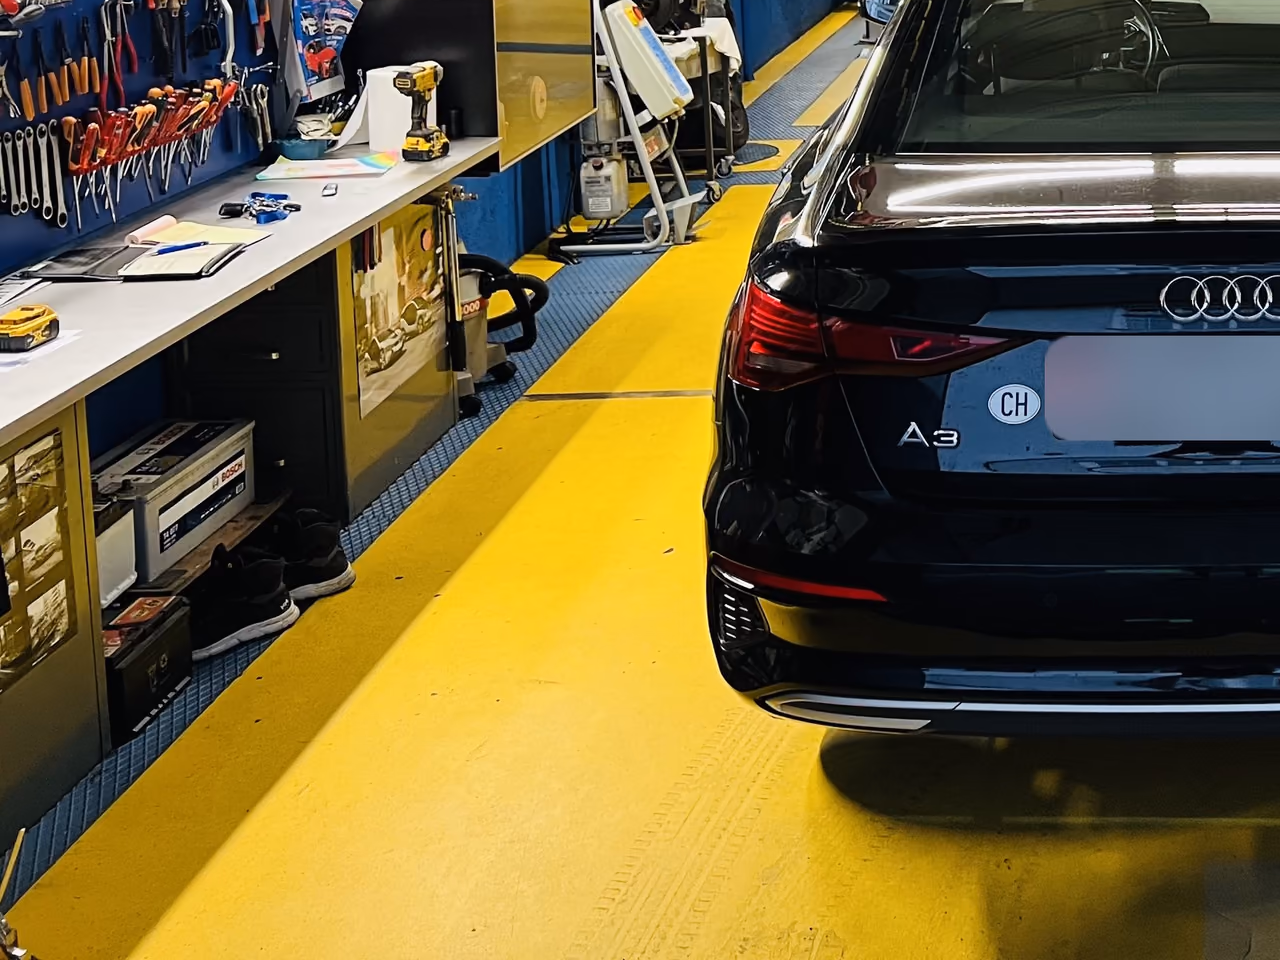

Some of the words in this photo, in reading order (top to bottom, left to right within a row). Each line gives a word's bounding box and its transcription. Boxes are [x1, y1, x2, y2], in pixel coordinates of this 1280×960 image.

[461, 300, 480, 315] 000
[1001, 392, 1028, 417] CH
[897, 421, 959, 448] A3
[221, 460, 243, 482] BOSCH
